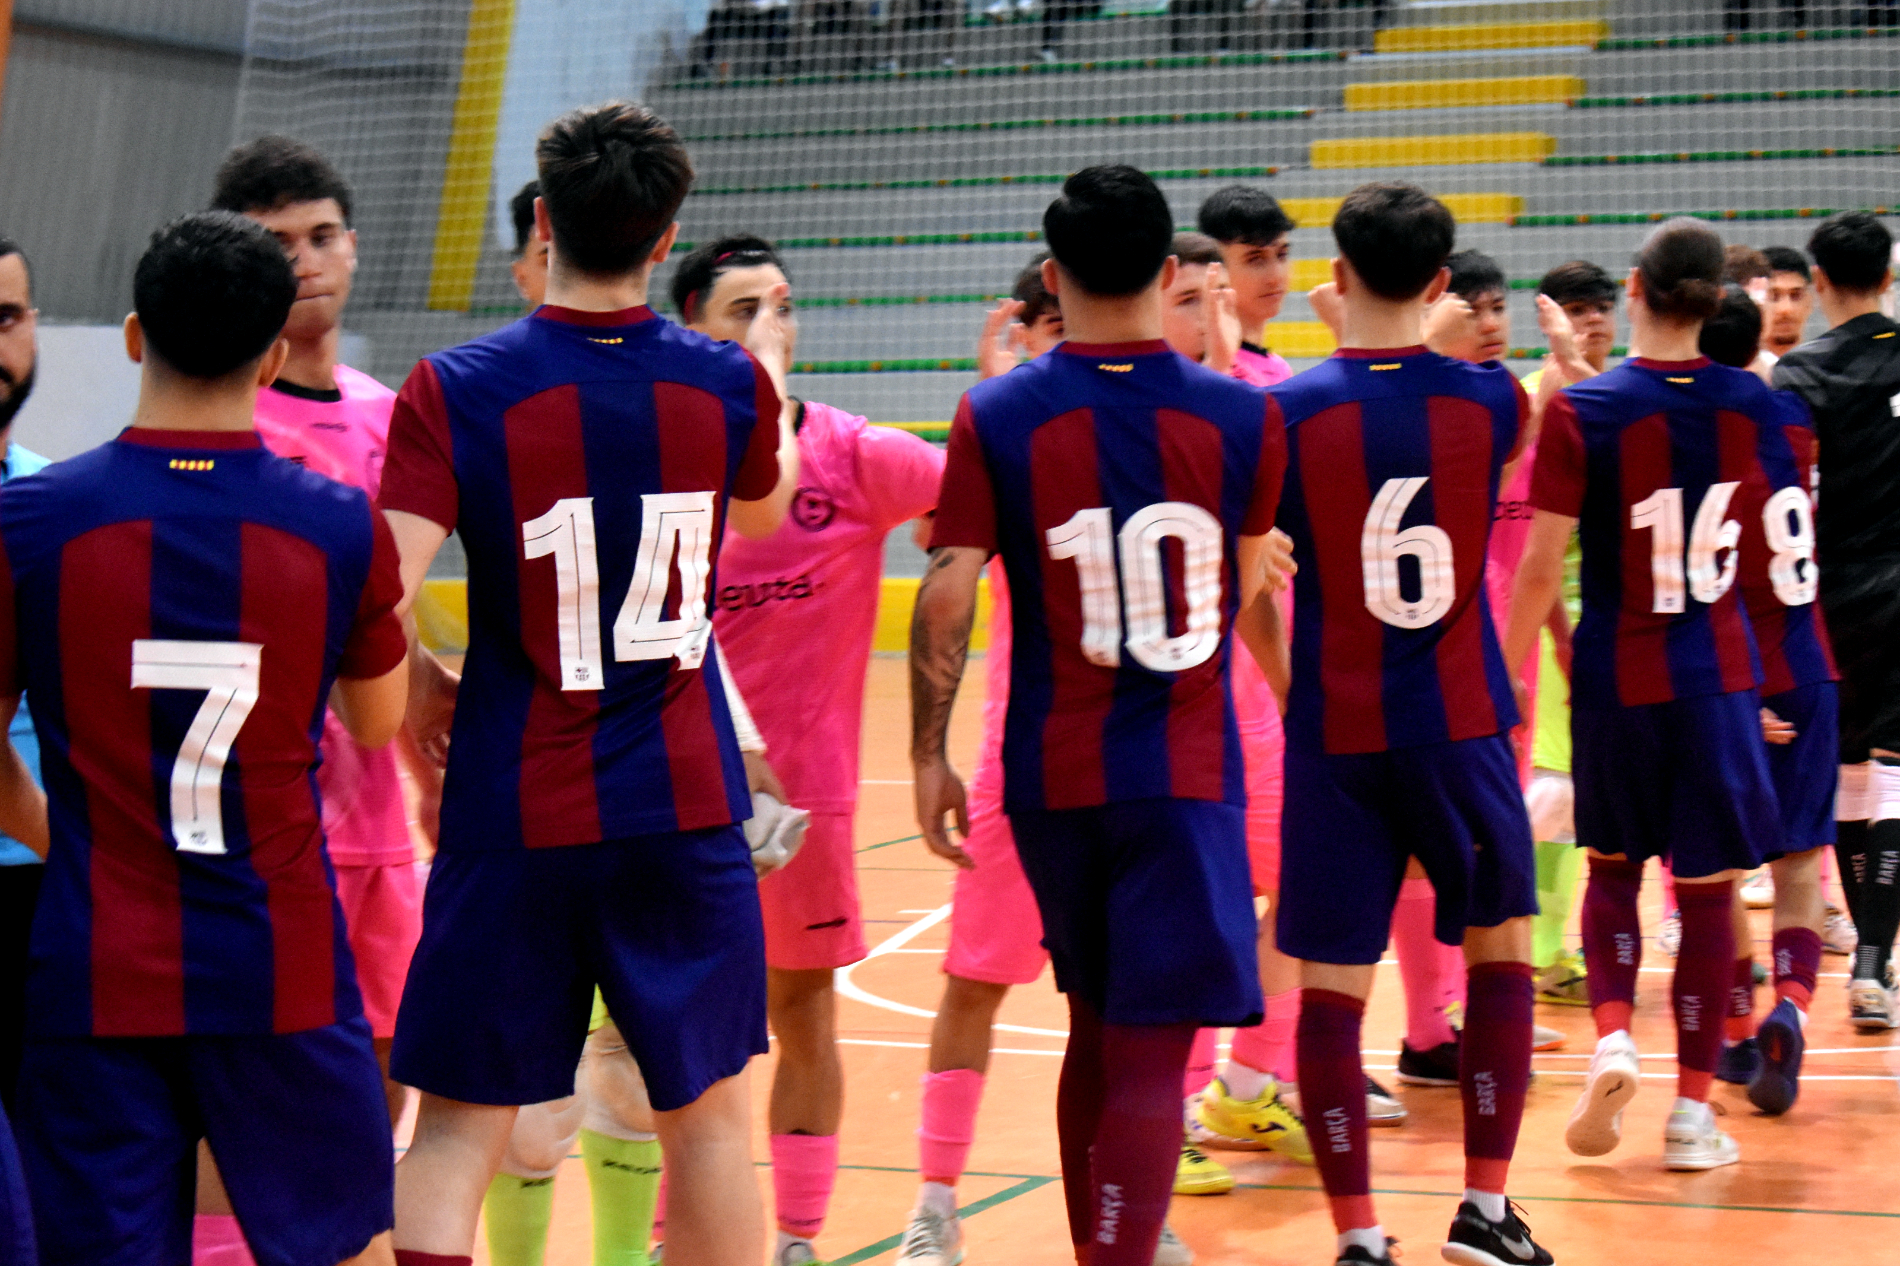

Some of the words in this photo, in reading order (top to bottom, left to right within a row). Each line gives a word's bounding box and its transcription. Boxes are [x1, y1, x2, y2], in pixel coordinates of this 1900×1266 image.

[522, 490, 720, 691] 14
[1046, 501, 1223, 672] 10
[1361, 476, 1456, 629] 6
[1631, 482, 1742, 614] 16
[1762, 486, 1819, 606] 8
[131, 639, 263, 855] 7
